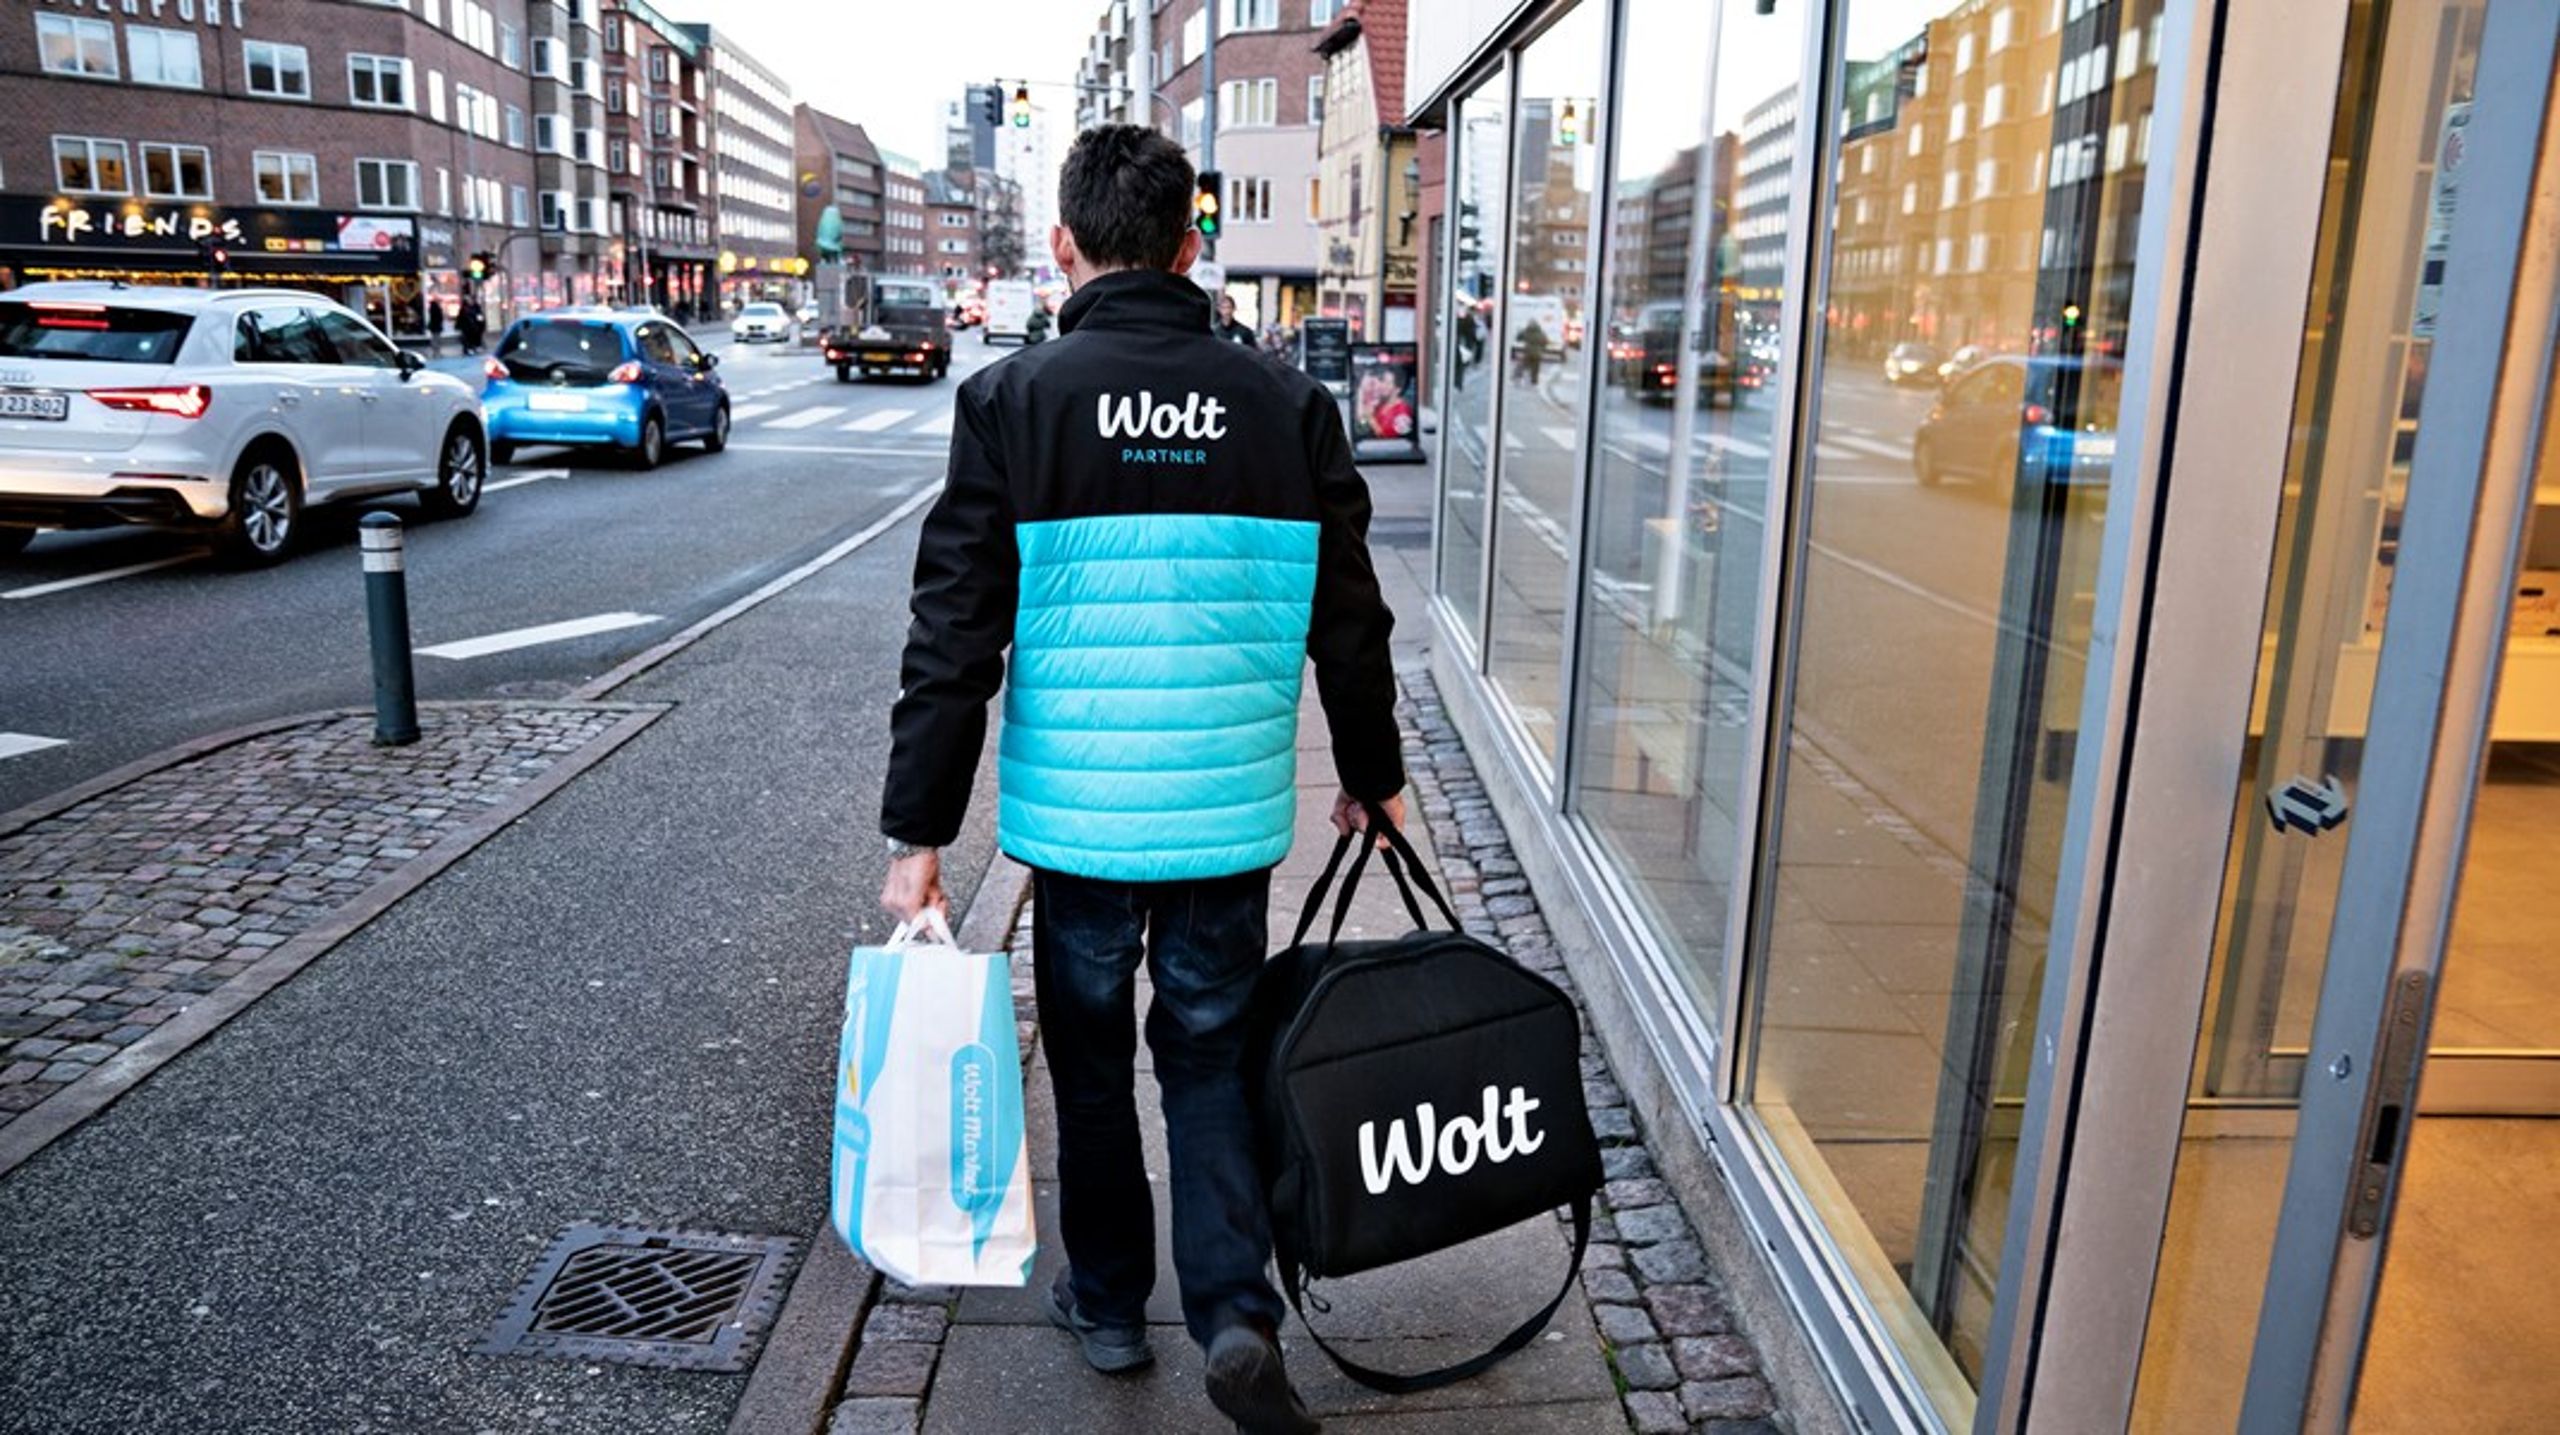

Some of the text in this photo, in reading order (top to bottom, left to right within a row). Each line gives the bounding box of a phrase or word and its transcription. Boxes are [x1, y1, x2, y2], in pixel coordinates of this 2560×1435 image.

[8, 396, 27, 412] 23
[1097, 389, 1228, 439] Wolt
[1121, 448, 1207, 464] PARTNER
[962, 1063, 982, 1114] Wolt
[1358, 1084, 1546, 1195] Wolt
